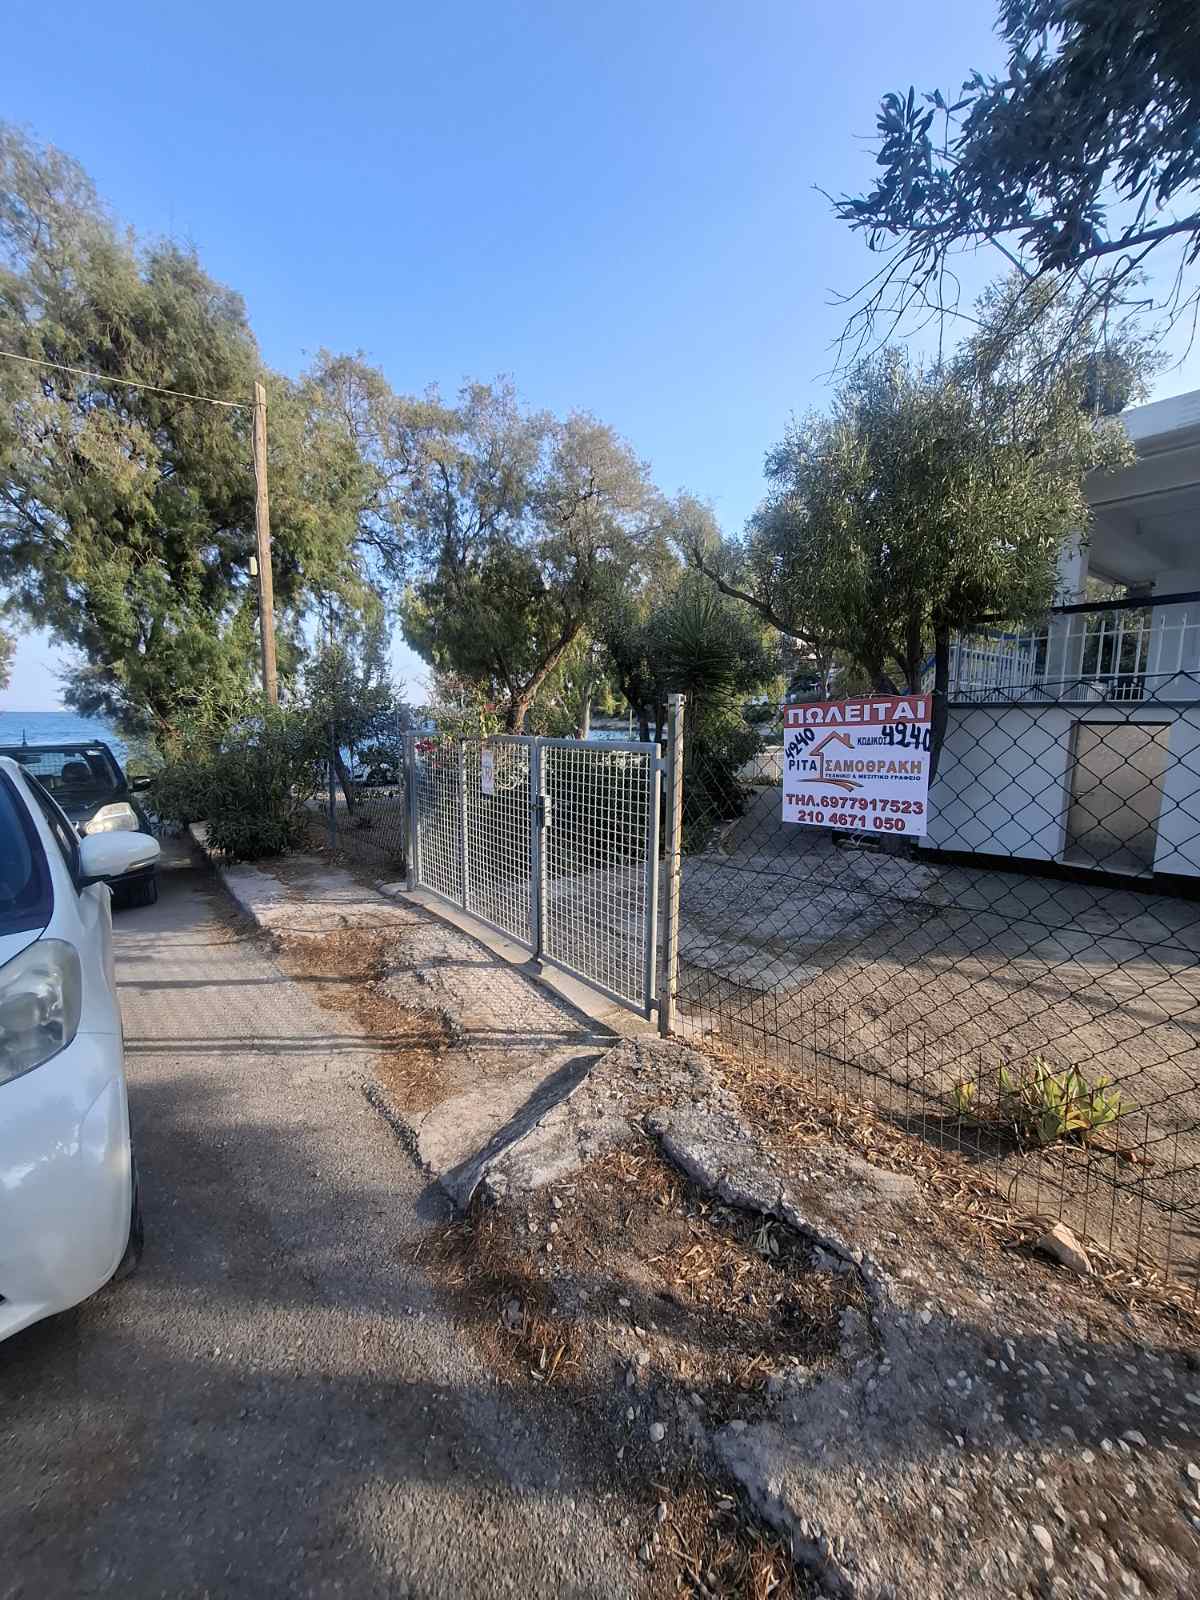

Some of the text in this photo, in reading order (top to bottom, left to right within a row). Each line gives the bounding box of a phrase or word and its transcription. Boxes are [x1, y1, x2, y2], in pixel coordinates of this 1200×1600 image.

[788, 701, 926, 724] ΠΩΛΕΙΤΑΙ
[788, 759, 922, 774] ΡΙΤΑ ΣΑΜΟΘΡΑΚΗ
[785, 793, 924, 815] ΤΗΛ.6977917523
[798, 810, 906, 832] 210 4671 050
